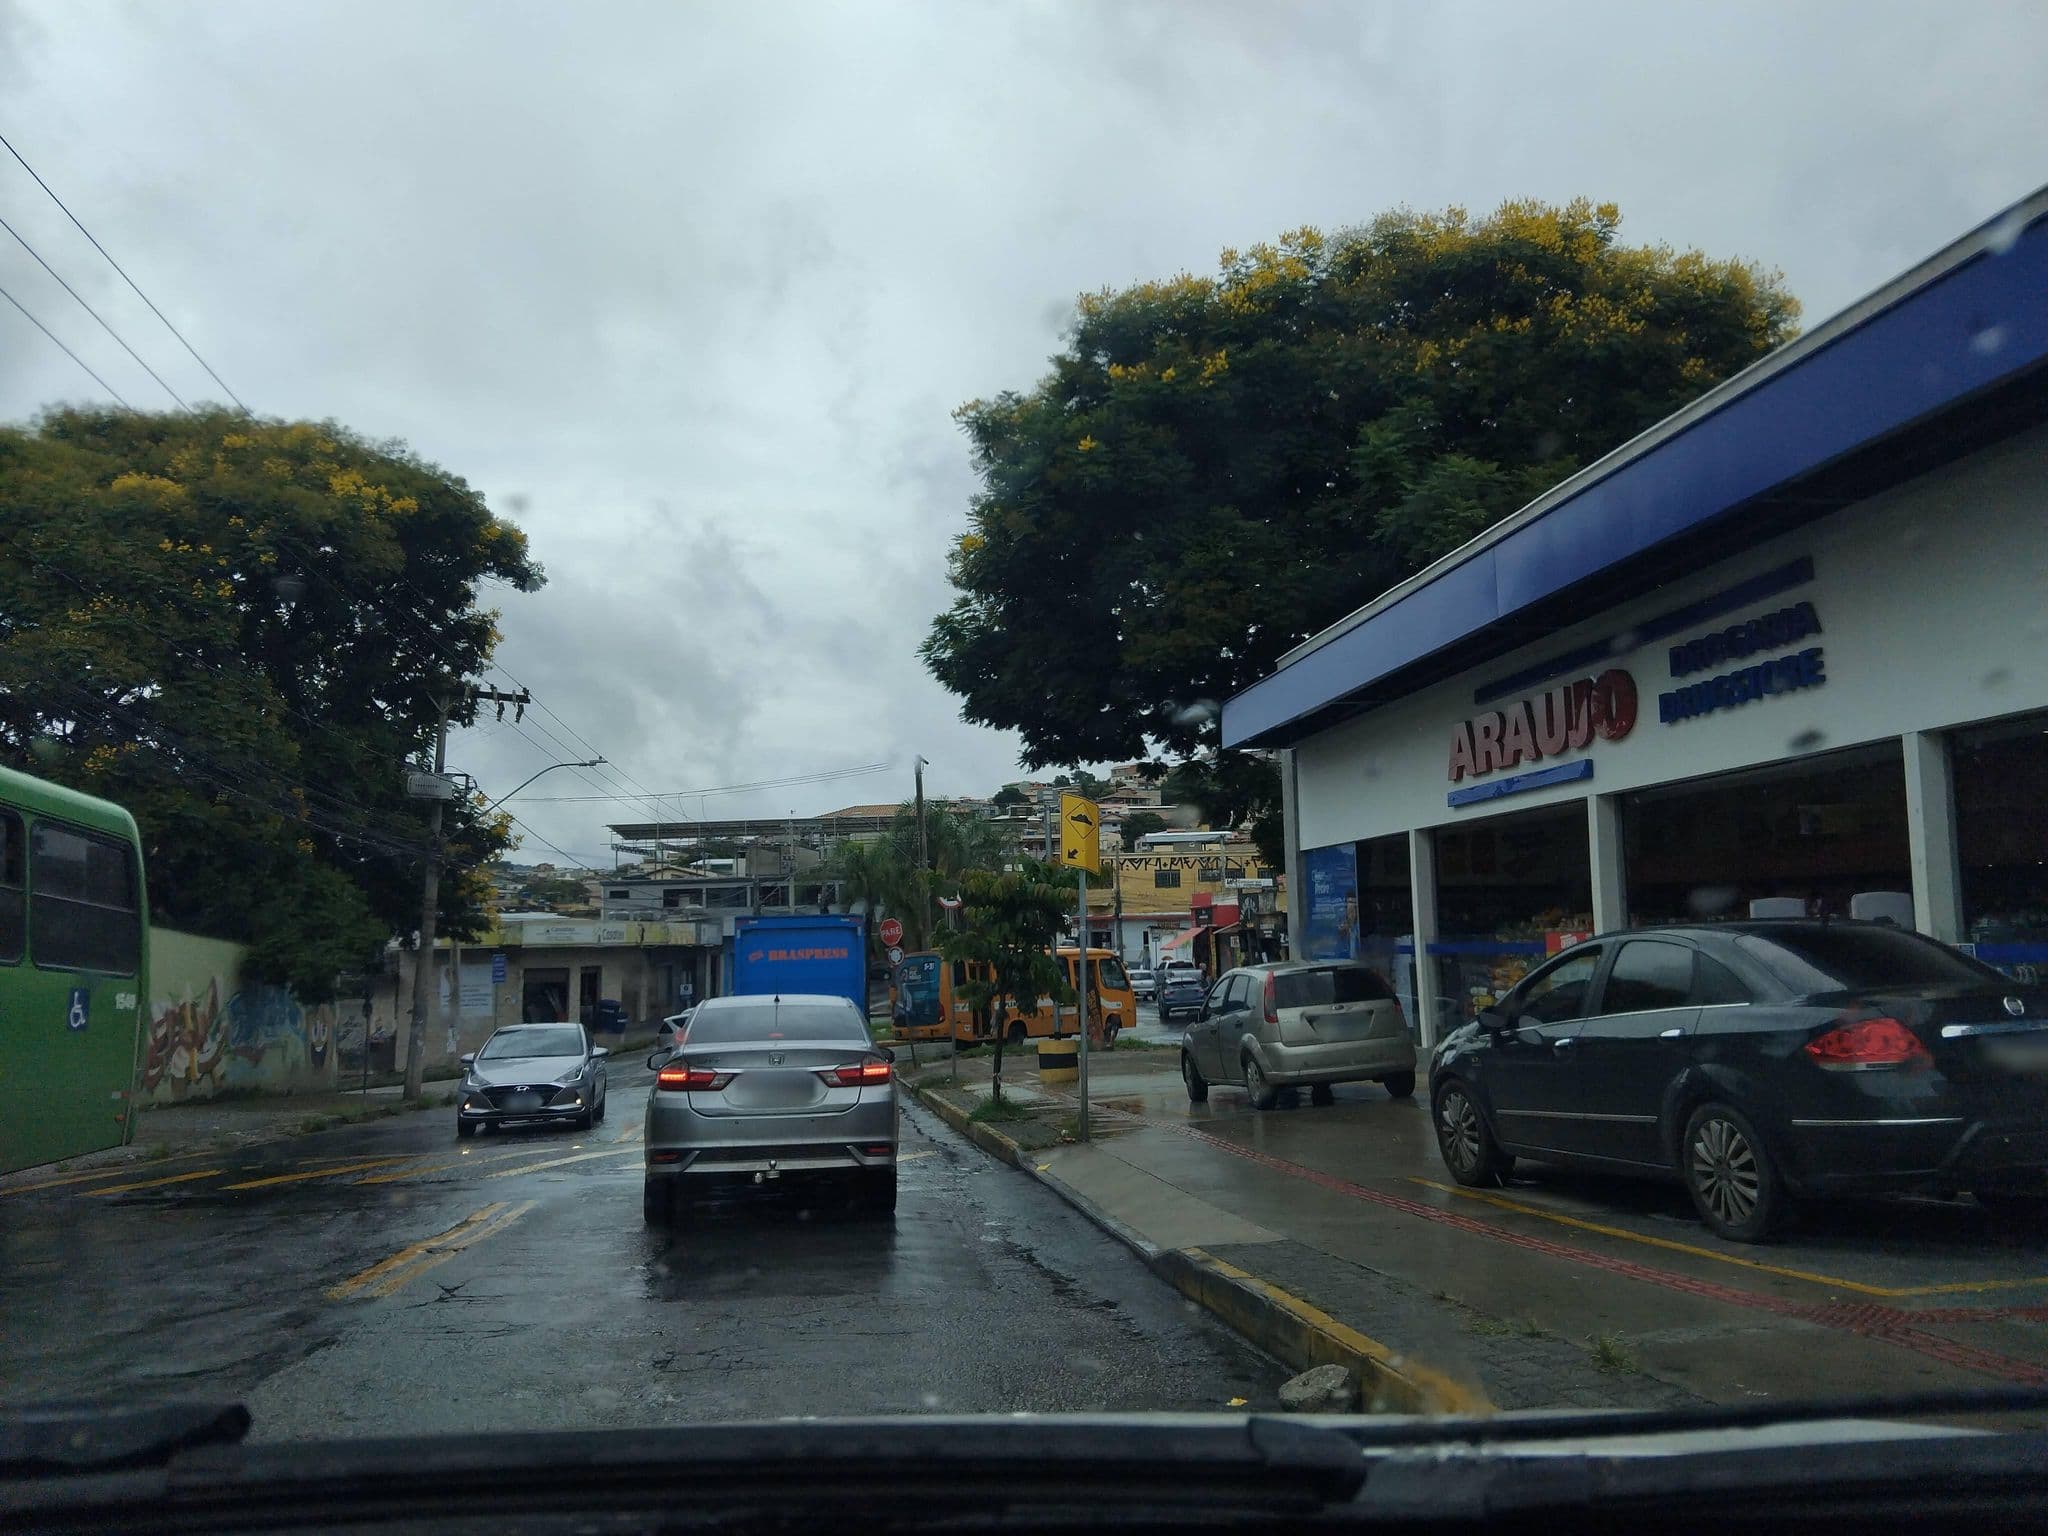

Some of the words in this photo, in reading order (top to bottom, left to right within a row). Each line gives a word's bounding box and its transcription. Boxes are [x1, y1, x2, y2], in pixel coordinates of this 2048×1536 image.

[1447, 669, 1638, 782] ARAUJO
[881, 926, 901, 938] PARE
[767, 947, 849, 961] BRASPRESS
